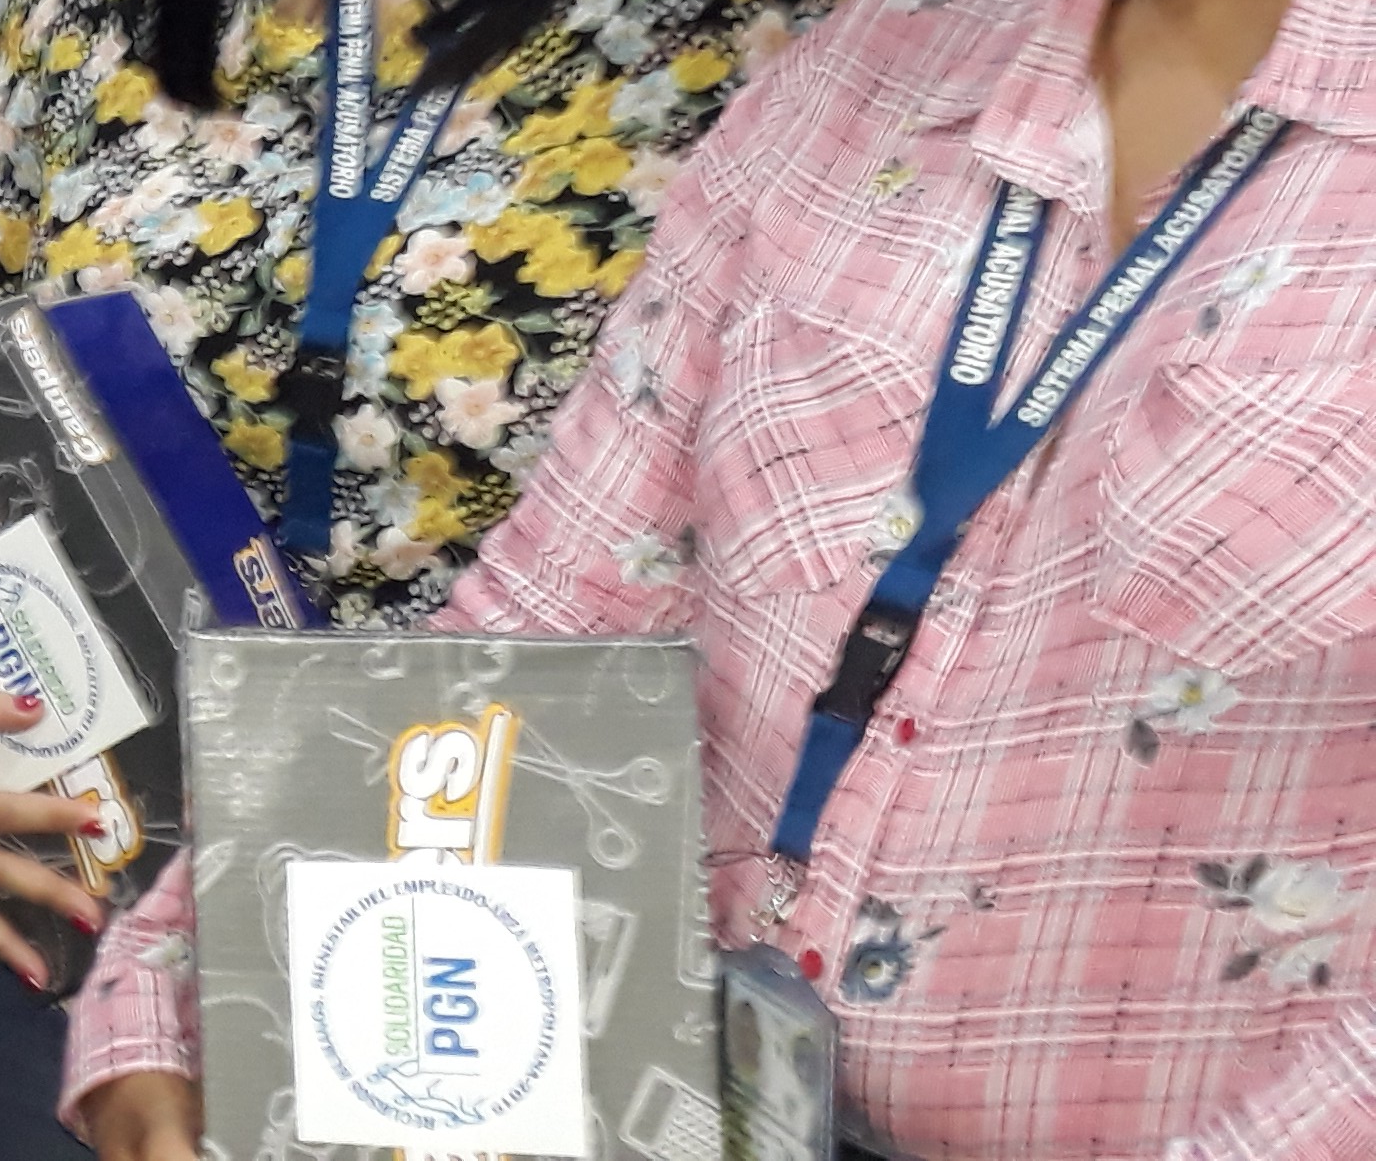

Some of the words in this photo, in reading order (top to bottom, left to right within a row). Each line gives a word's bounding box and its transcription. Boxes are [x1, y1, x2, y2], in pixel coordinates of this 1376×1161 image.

[337, 35, 370, 86] PENAL
[329, 84, 369, 200] ACUSATORIO
[370, 127, 431, 202] SISTEMA
[950, 241, 1027, 386] ACUSATORIO
[1018, 328, 1106, 427] SISTEMA
[1089, 256, 1162, 328] PENAL
[1153, 110, 1280, 256] ACUSATORIO
[10, 312, 105, 462] Campers
[381, 915, 411, 1057] SOLIDARIDAD
[423, 956, 480, 1058] PGN
